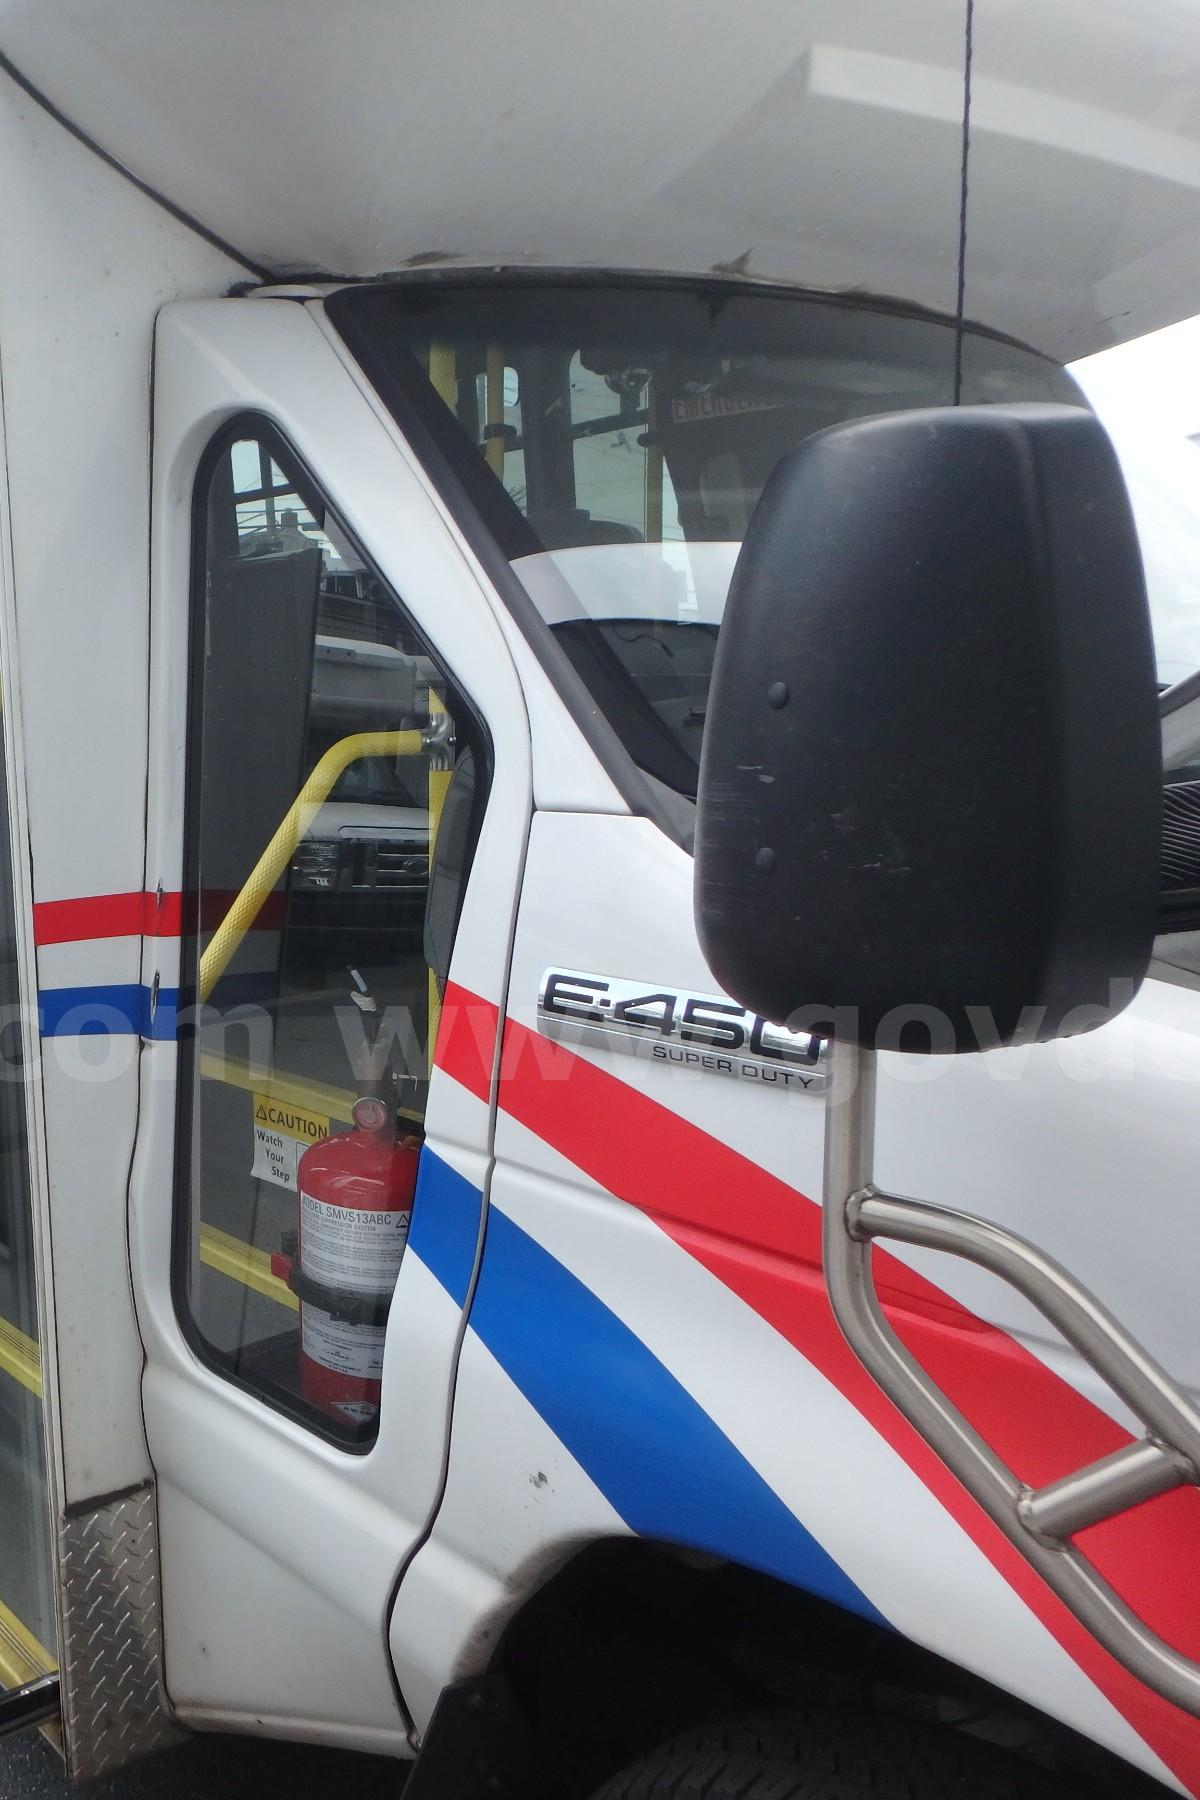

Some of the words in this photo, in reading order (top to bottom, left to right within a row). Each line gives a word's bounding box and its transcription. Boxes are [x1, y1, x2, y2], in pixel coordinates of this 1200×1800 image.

[653, 1046, 732, 1072] SUPER
[742, 1065, 813, 1089] DUTY
[268, 1108, 328, 1139] CAUTION
[257, 1129, 282, 1148] Watch
[265, 1148, 284, 1163] Your
[271, 1166, 290, 1182] Step
[326, 1206, 392, 1225] SMVS13ABC
